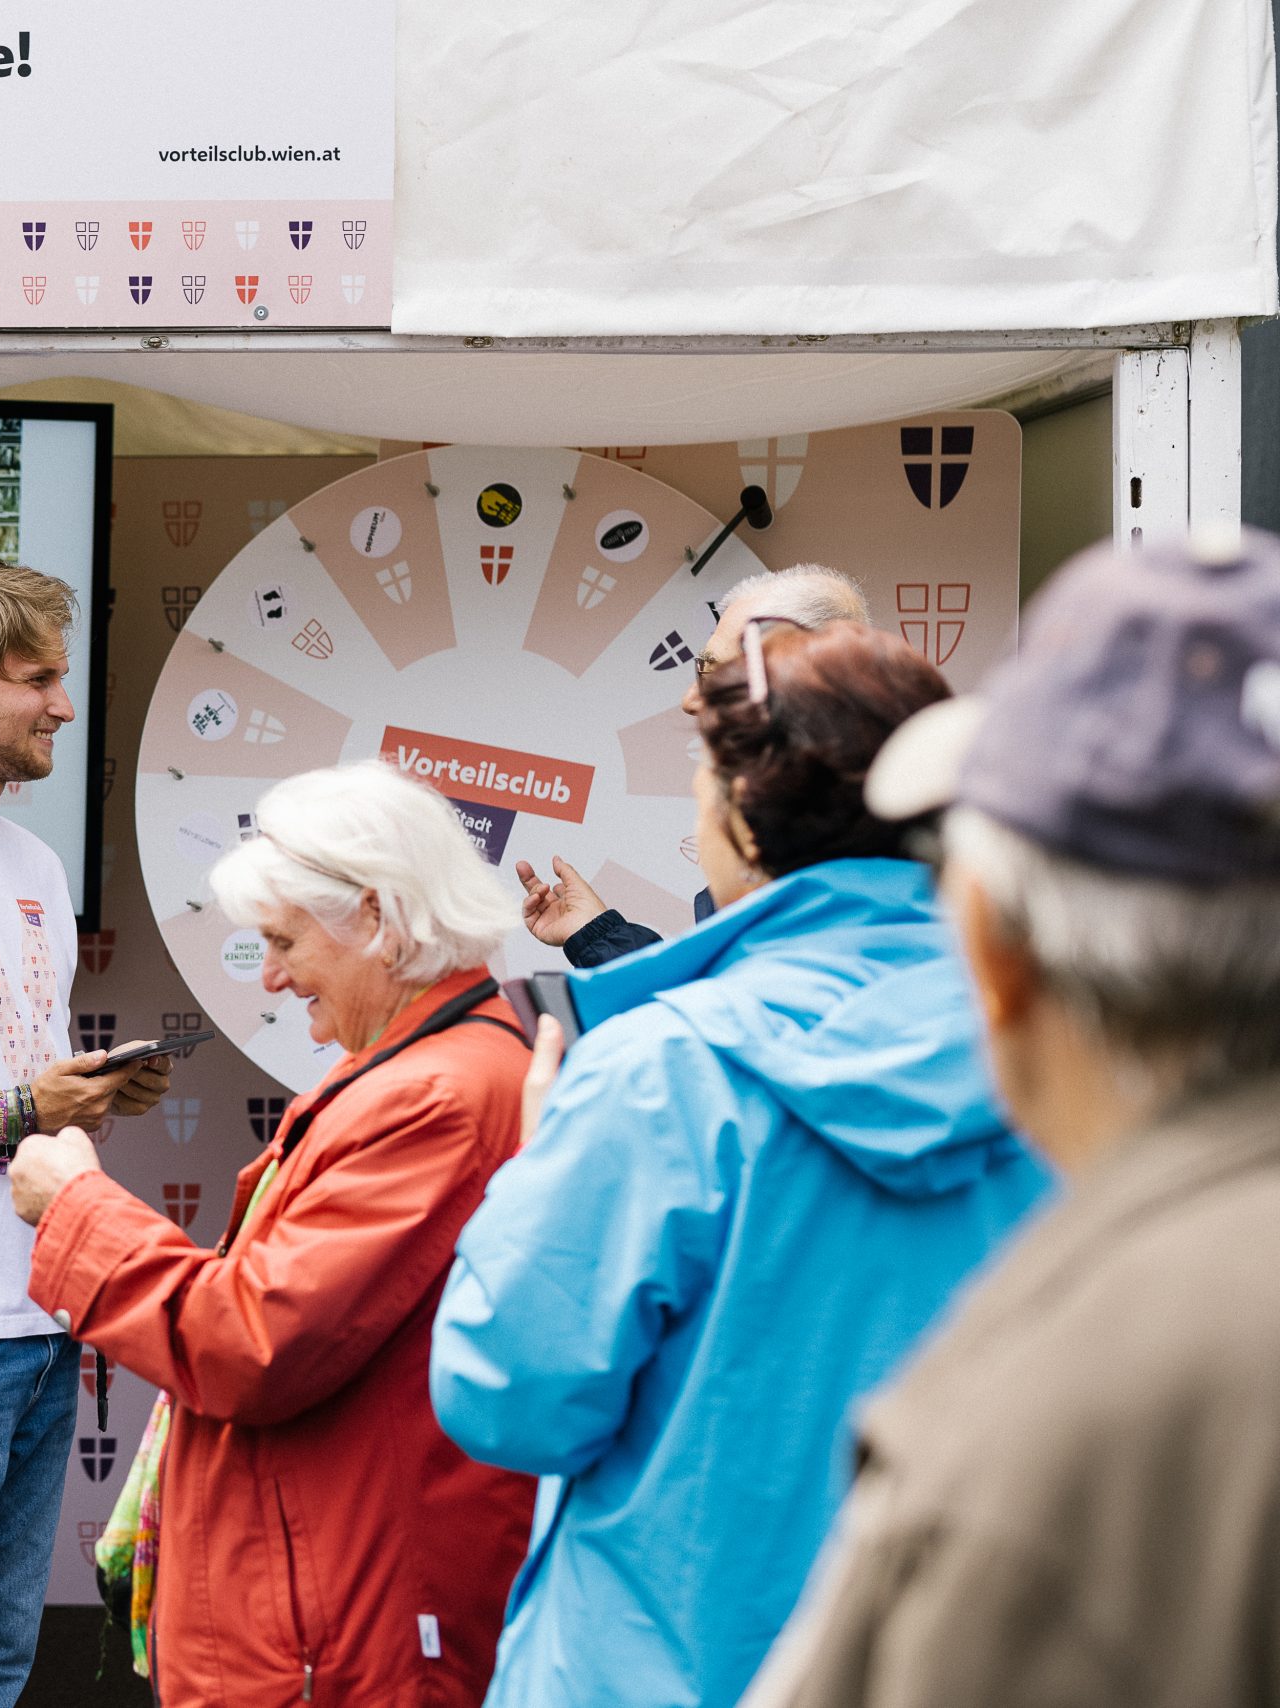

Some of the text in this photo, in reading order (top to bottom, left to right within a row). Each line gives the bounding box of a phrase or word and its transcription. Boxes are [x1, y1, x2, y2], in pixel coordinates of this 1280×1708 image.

[158, 145, 341, 162] vorteilsclub.wien.at
[364, 512, 380, 553] ORPHEUM
[397, 745, 571, 804] Vorteilsclub
